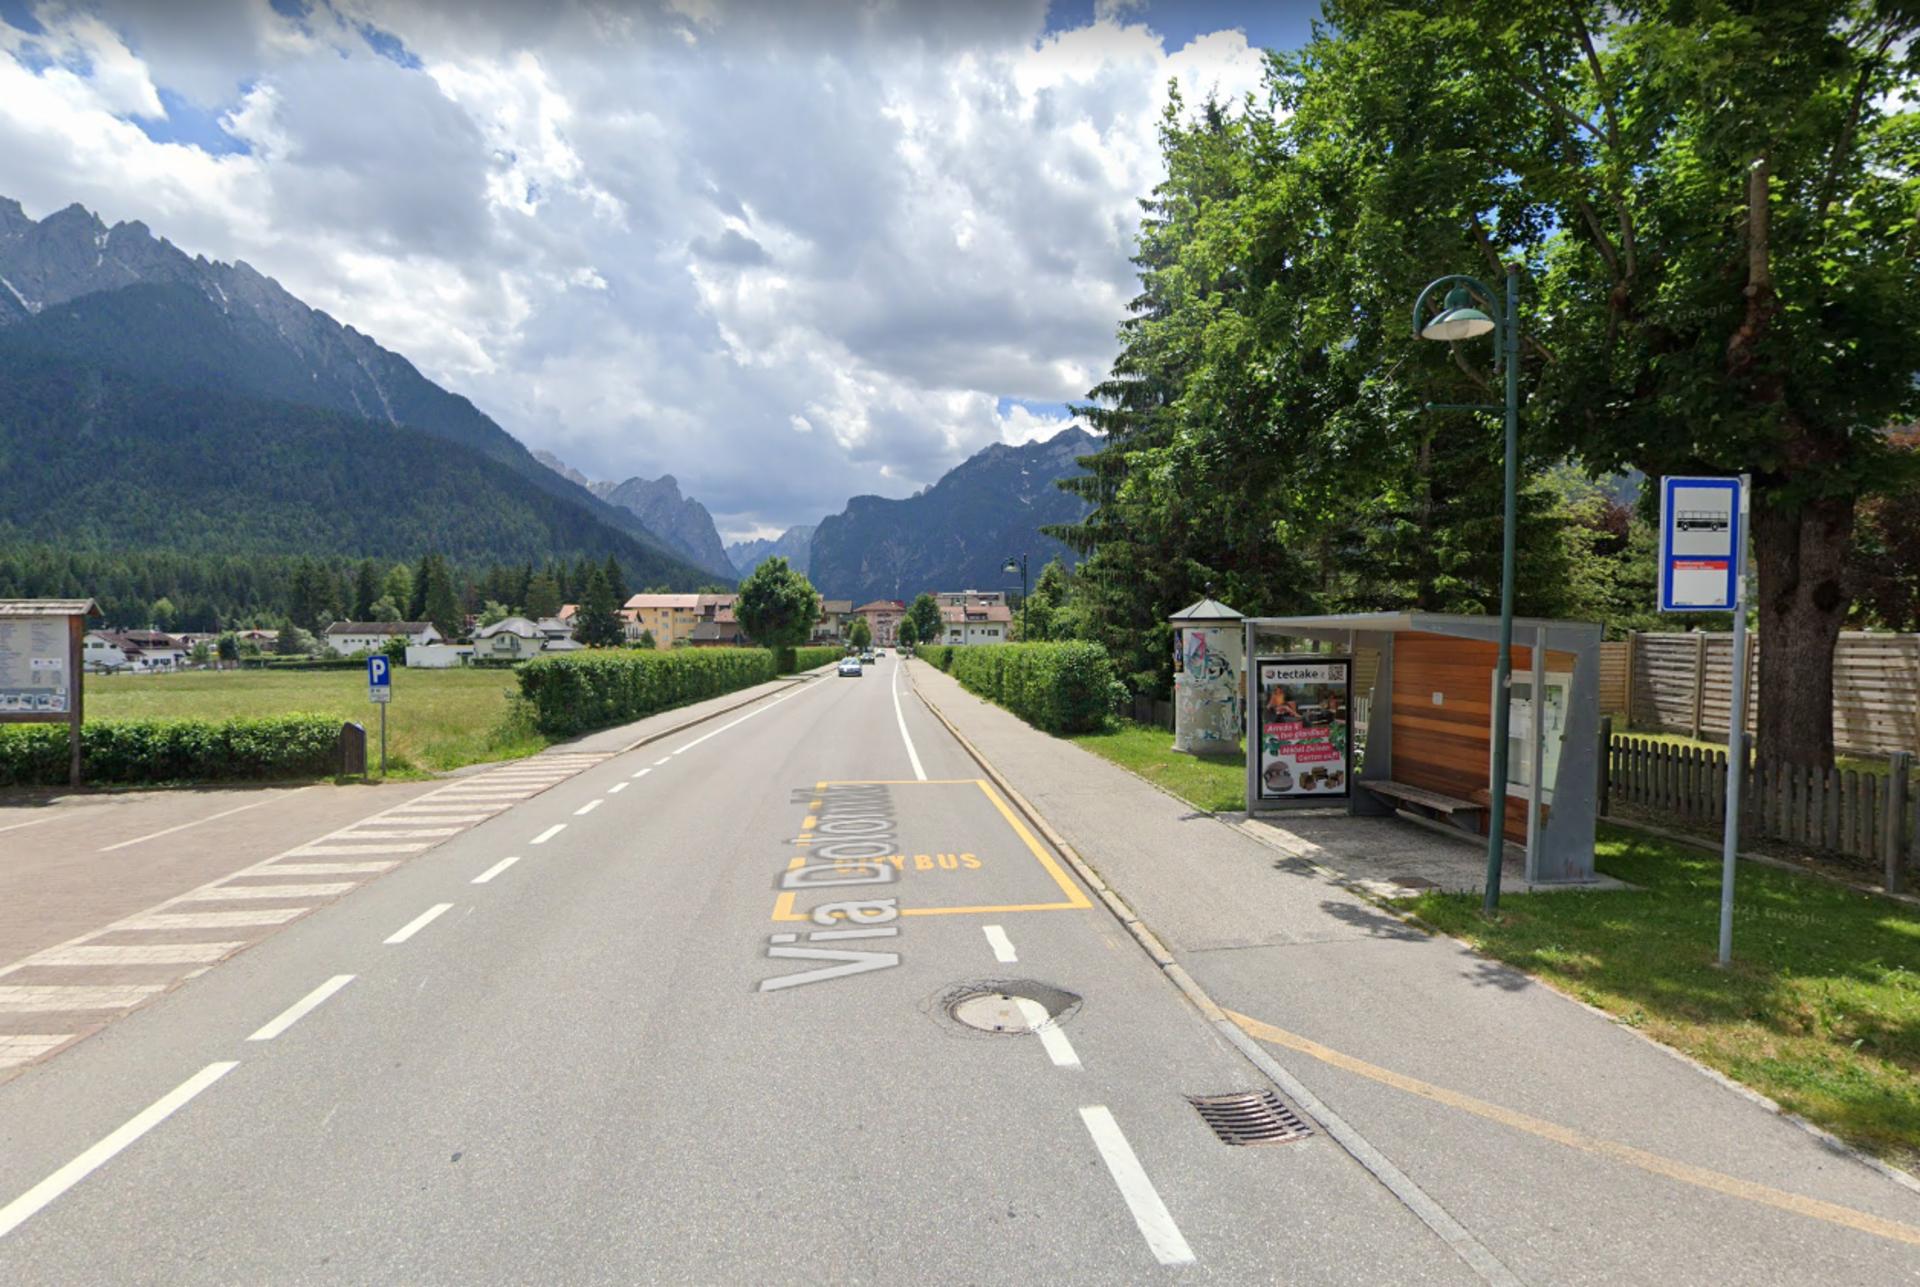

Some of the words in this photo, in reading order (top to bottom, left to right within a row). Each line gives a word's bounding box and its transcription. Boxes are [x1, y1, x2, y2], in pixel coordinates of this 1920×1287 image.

[372, 659, 386, 683] P
[1277, 668, 1319, 679] tectake
[913, 852, 982, 871] BUS
